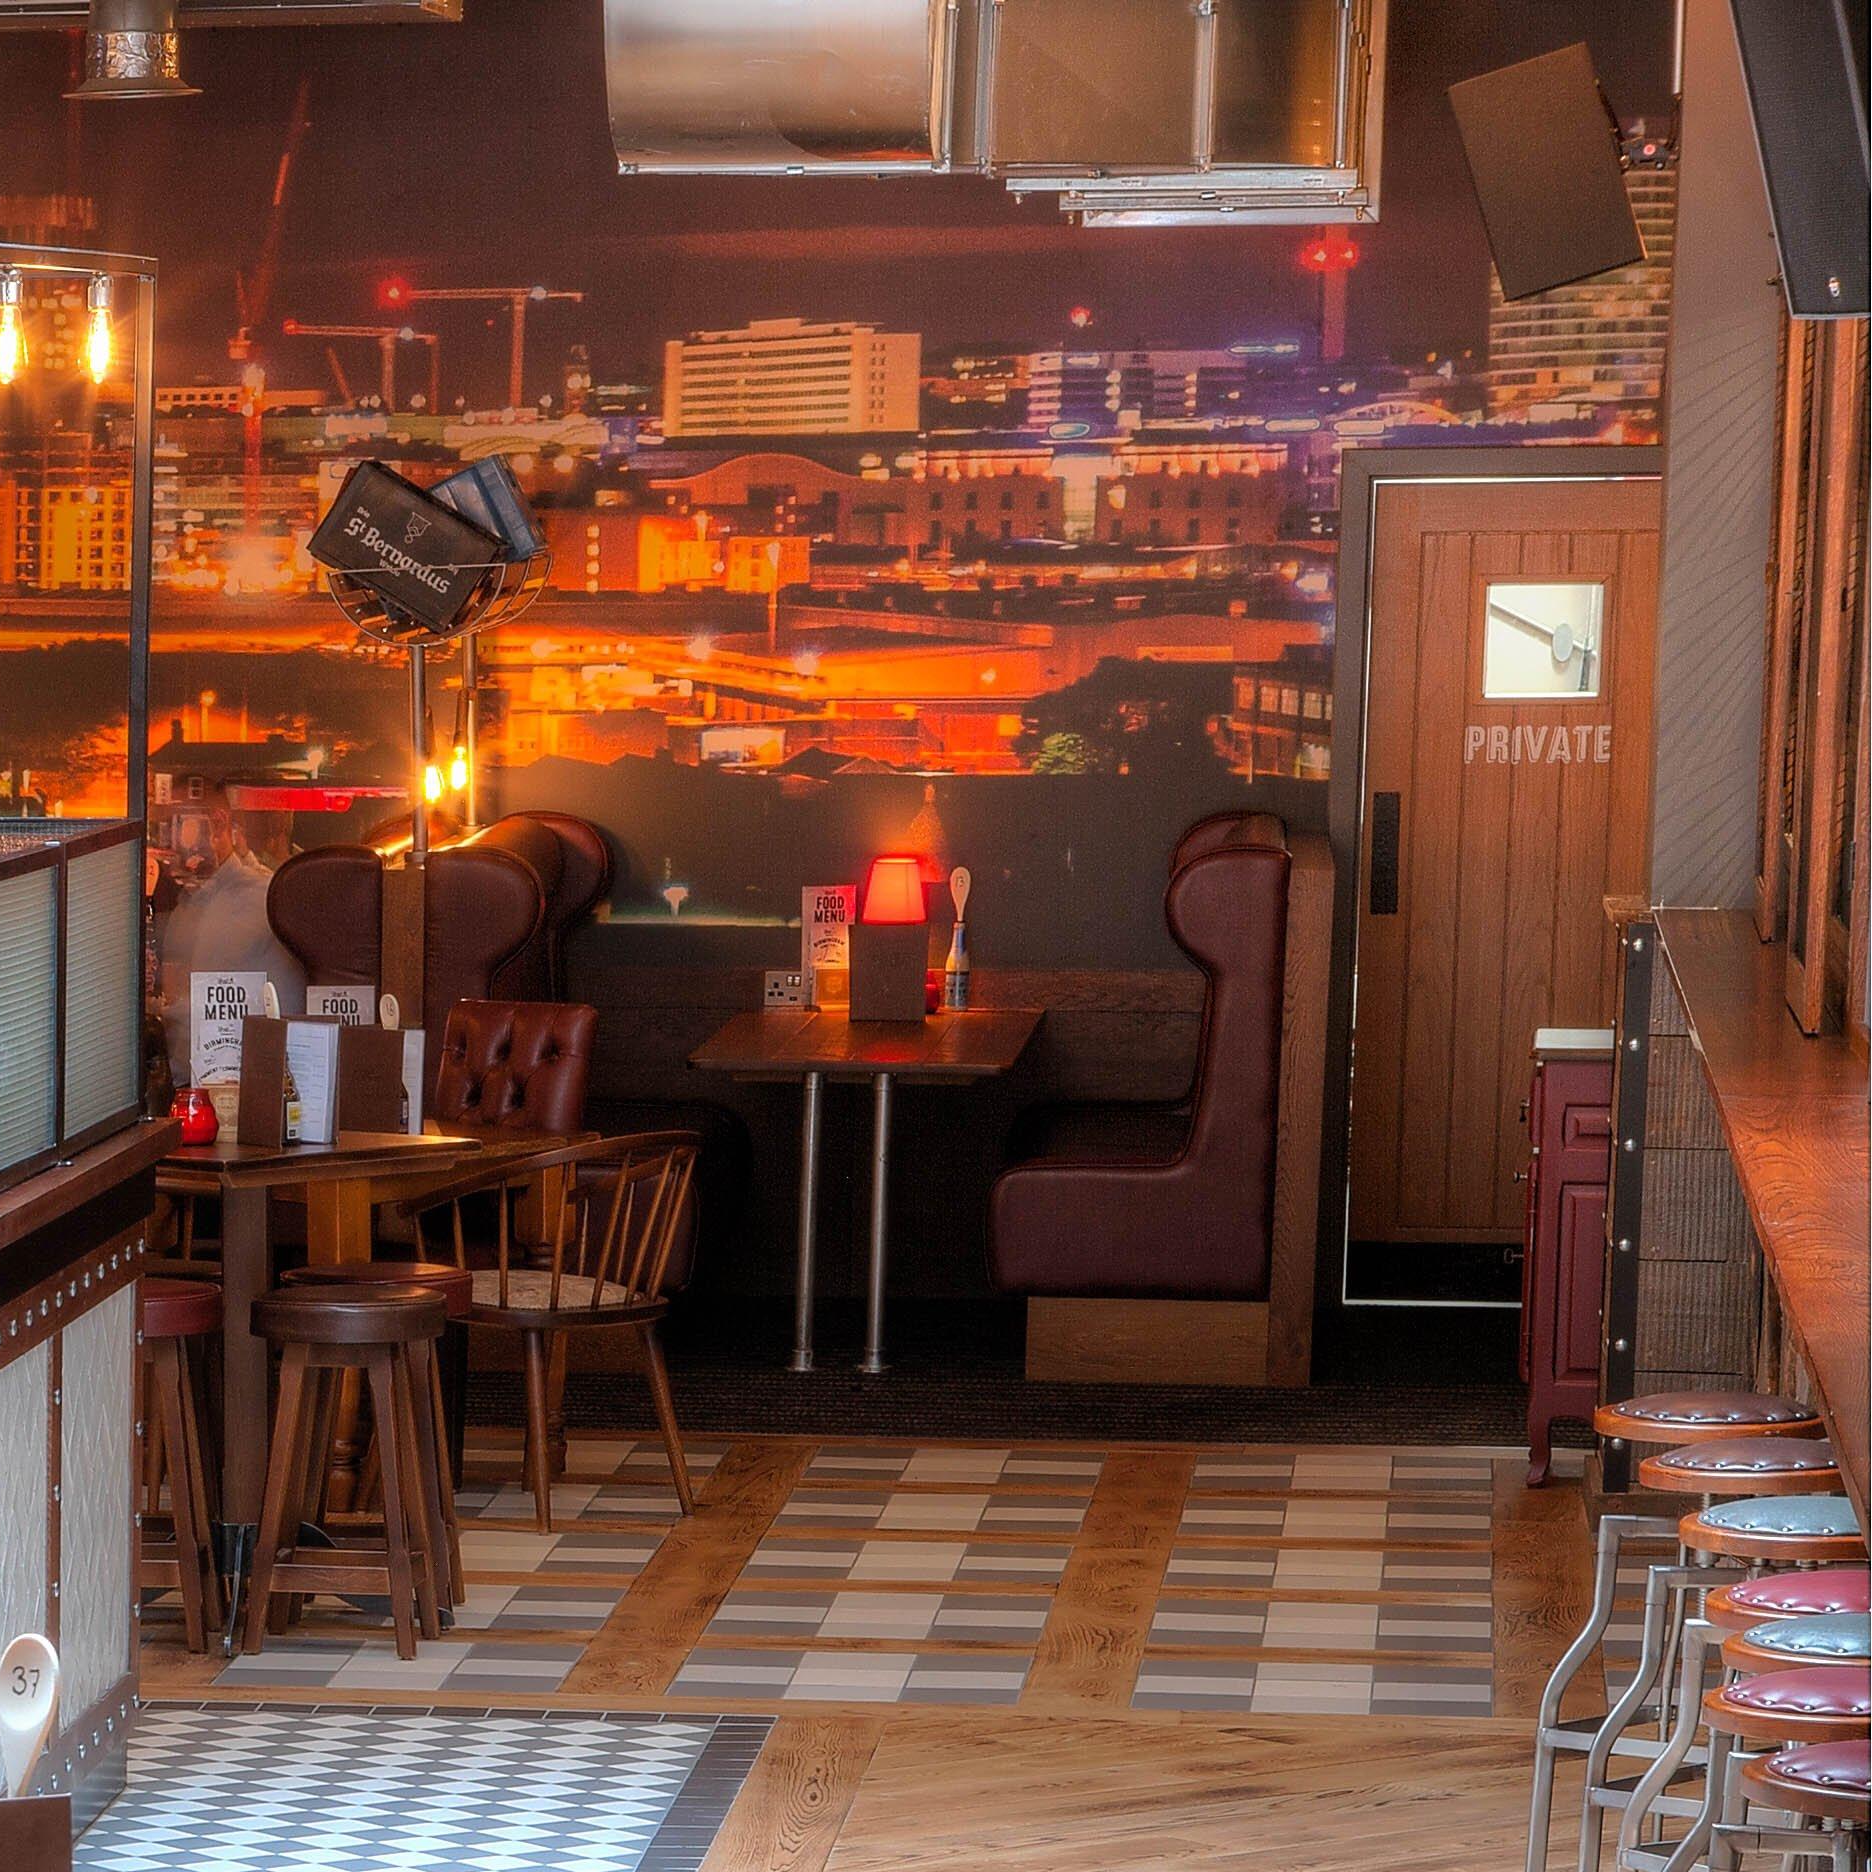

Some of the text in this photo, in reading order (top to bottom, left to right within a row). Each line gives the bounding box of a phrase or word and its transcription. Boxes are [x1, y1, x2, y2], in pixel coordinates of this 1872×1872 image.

[359, 526, 452, 595] Bernardus
[1463, 725, 1613, 766] PRIVATE
[816, 895, 846, 910] FOOD
[813, 909, 846, 924] MENU
[207, 986, 247, 1004] FOOD
[204, 1003, 249, 1021] MENU
[322, 998, 359, 1014] FOOD
[11, 1665, 41, 1698] 37
